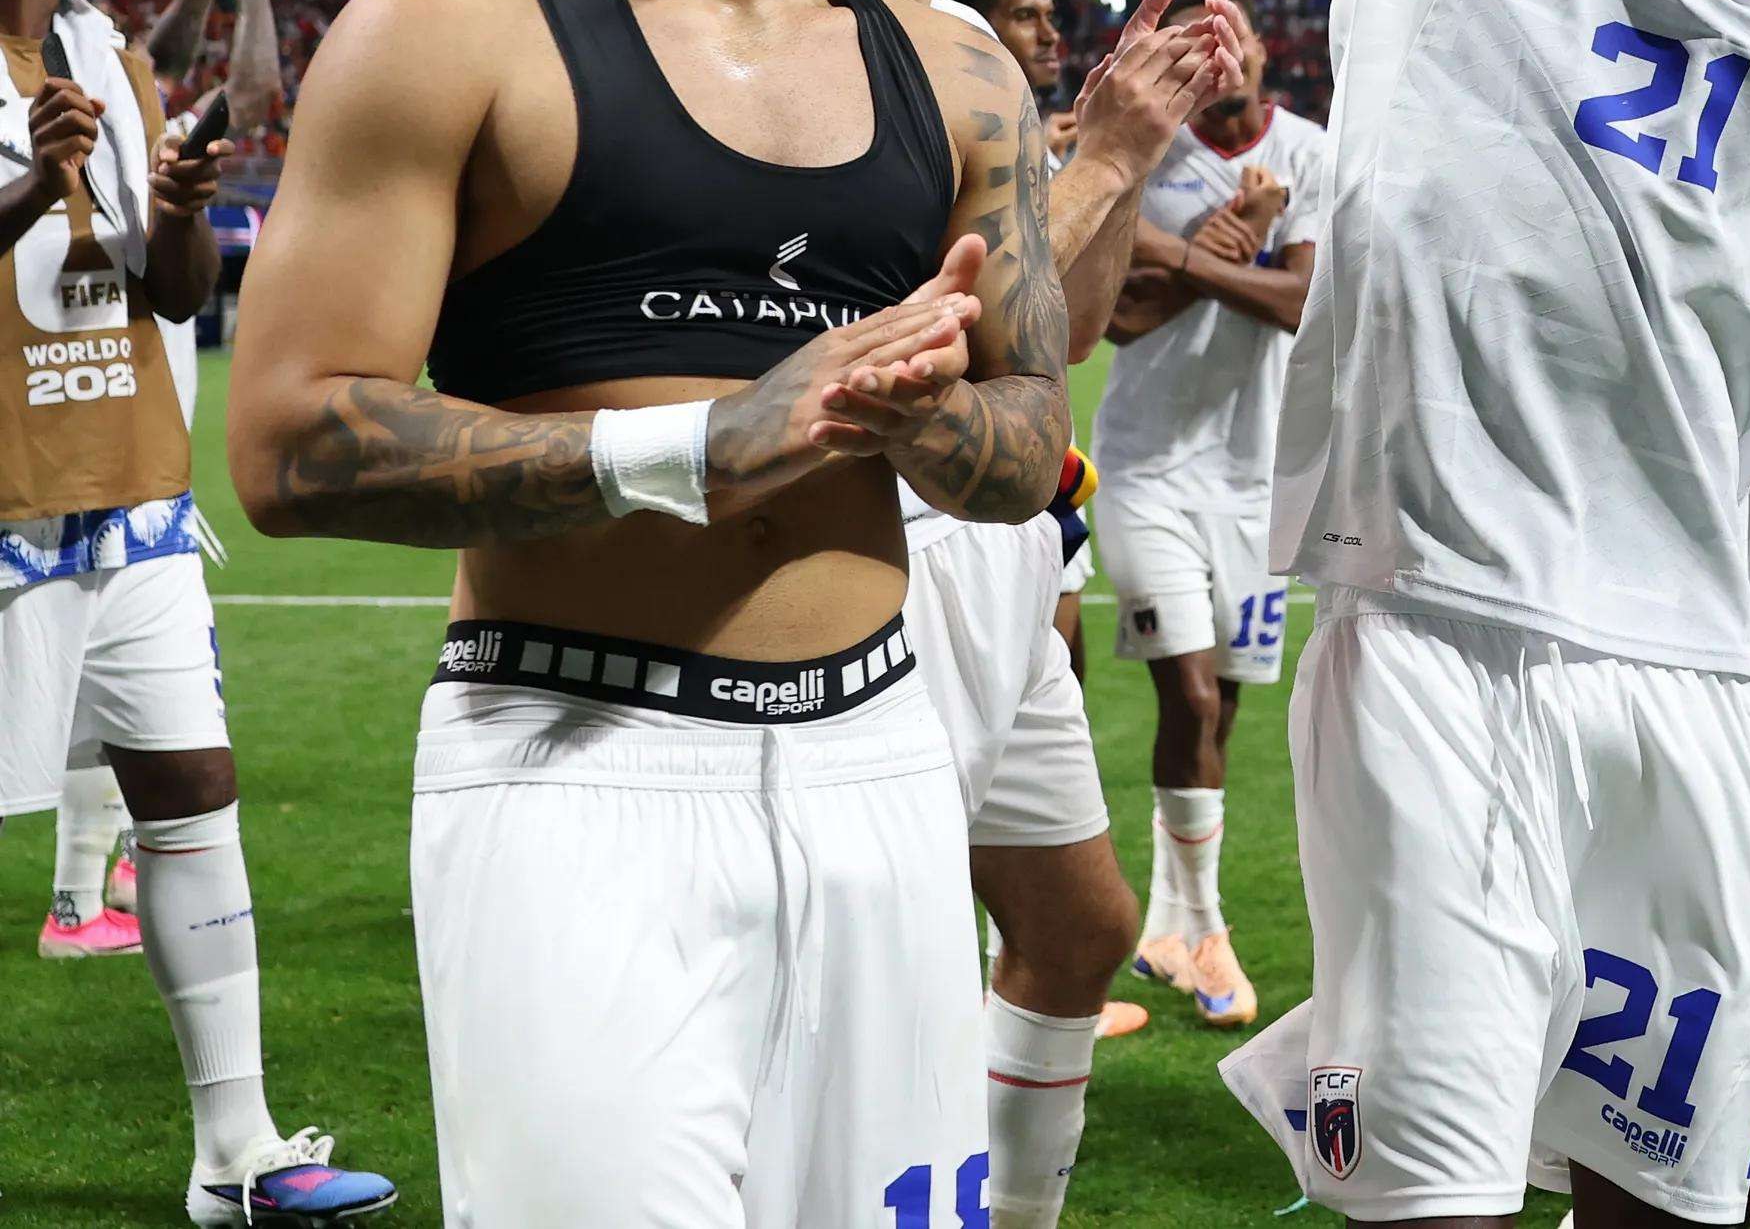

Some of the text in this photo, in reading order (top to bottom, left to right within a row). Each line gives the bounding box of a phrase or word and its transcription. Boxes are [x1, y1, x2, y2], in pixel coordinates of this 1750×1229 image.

[60, 280, 122, 310] FIFA
[22, 337, 119, 368] WORLD
[1229, 589, 1287, 649] 15
[438, 630, 504, 670] apelli
[450, 660, 497, 673] SPORT
[710, 667, 825, 713] capelli
[766, 698, 825, 716] SPORT
[1560, 947, 1722, 1129] 21
[1314, 1073, 1356, 1092] FCF
[1601, 1103, 1688, 1161] capelli
[1629, 1140, 1680, 1168] SPORT
